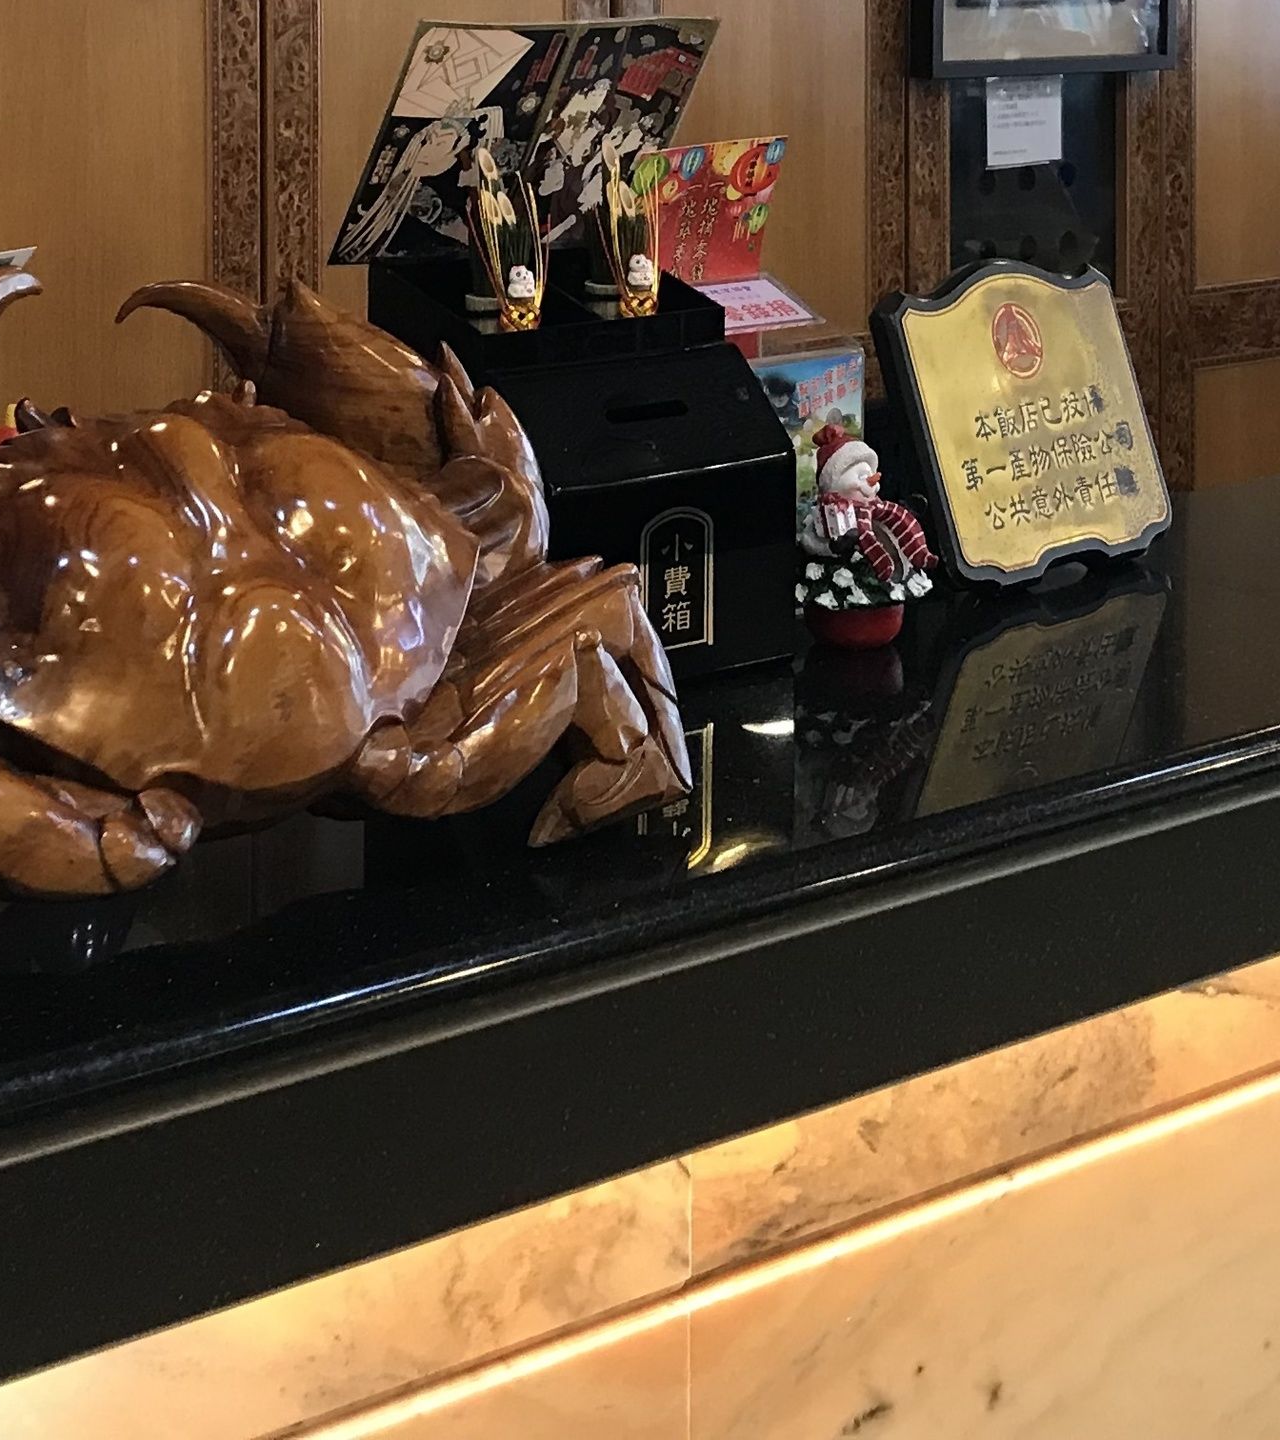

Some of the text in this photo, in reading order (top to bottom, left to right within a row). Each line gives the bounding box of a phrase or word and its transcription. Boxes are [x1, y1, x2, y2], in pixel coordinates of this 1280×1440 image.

[961, 420, 1133, 492] 第一產物保險公司
[984, 464, 1140, 531] 公共意外責任
[660, 533, 693, 633] 小費箱
